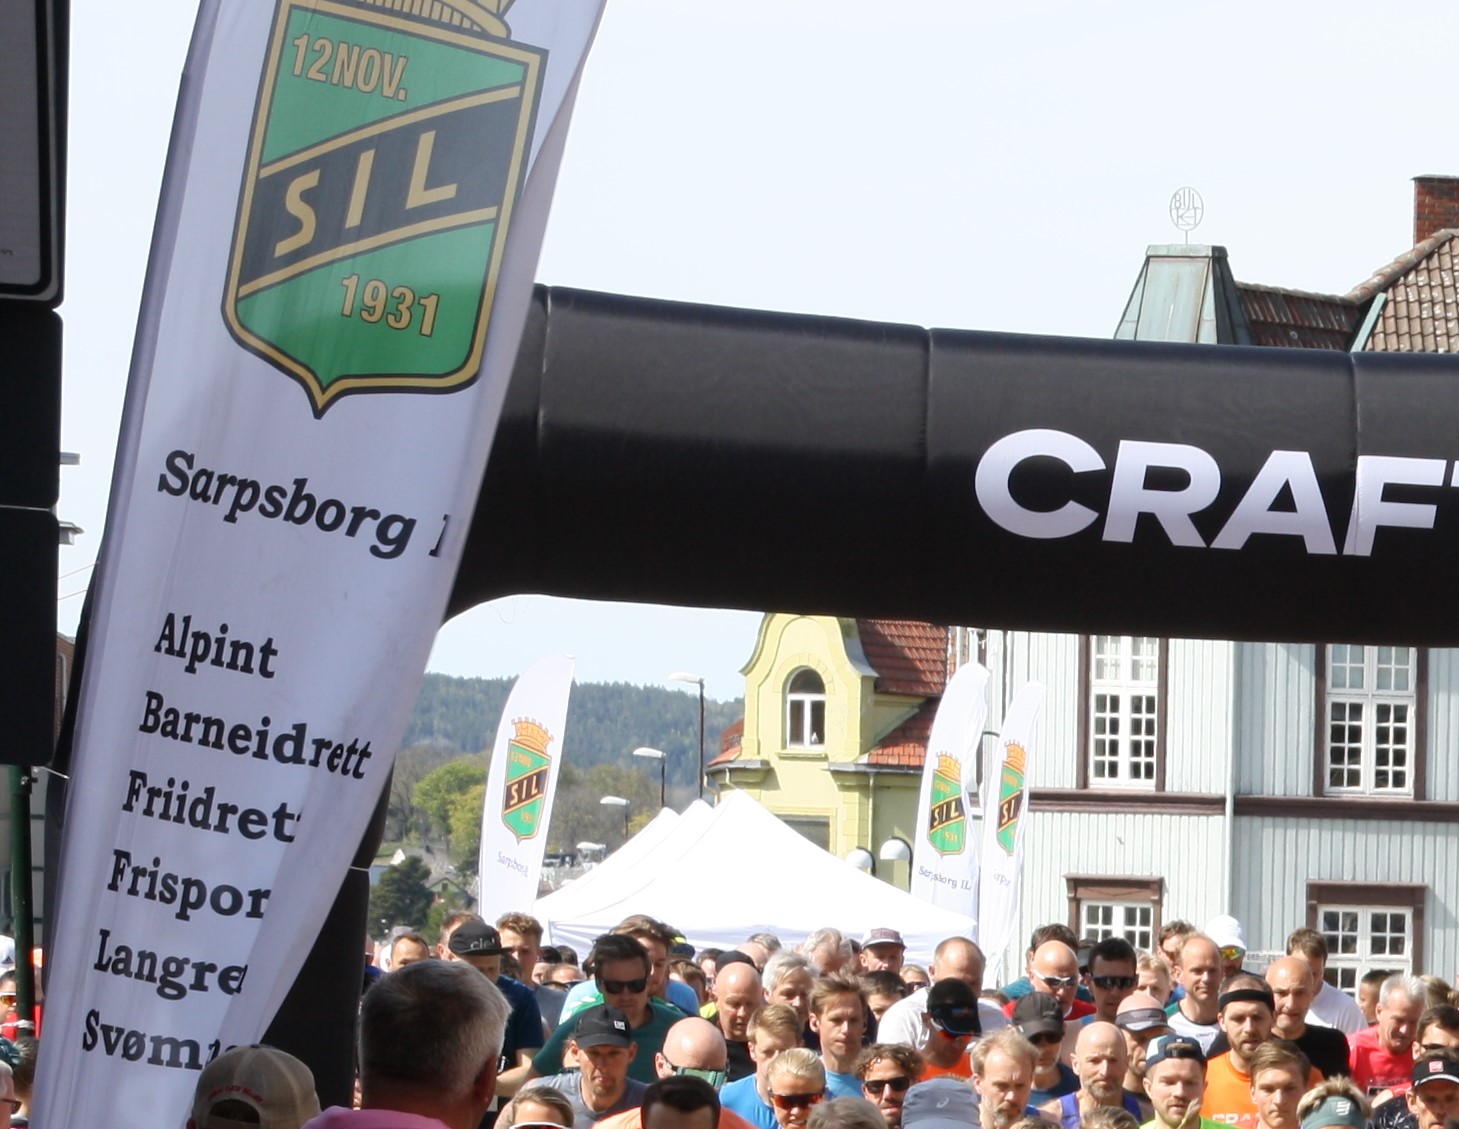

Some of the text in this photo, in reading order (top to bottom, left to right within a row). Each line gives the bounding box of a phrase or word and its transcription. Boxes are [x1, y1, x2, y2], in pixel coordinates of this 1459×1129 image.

[273, 130, 459, 259] SIL
[340, 273, 440, 337] 1931
[157, 449, 417, 560] Sarpsborg
[154, 612, 278, 679] Alpint
[139, 690, 372, 779] Barneidrett
[122, 769, 302, 843] Friidret
[510, 775, 539, 805] SIL
[933, 801, 959, 826] SIL
